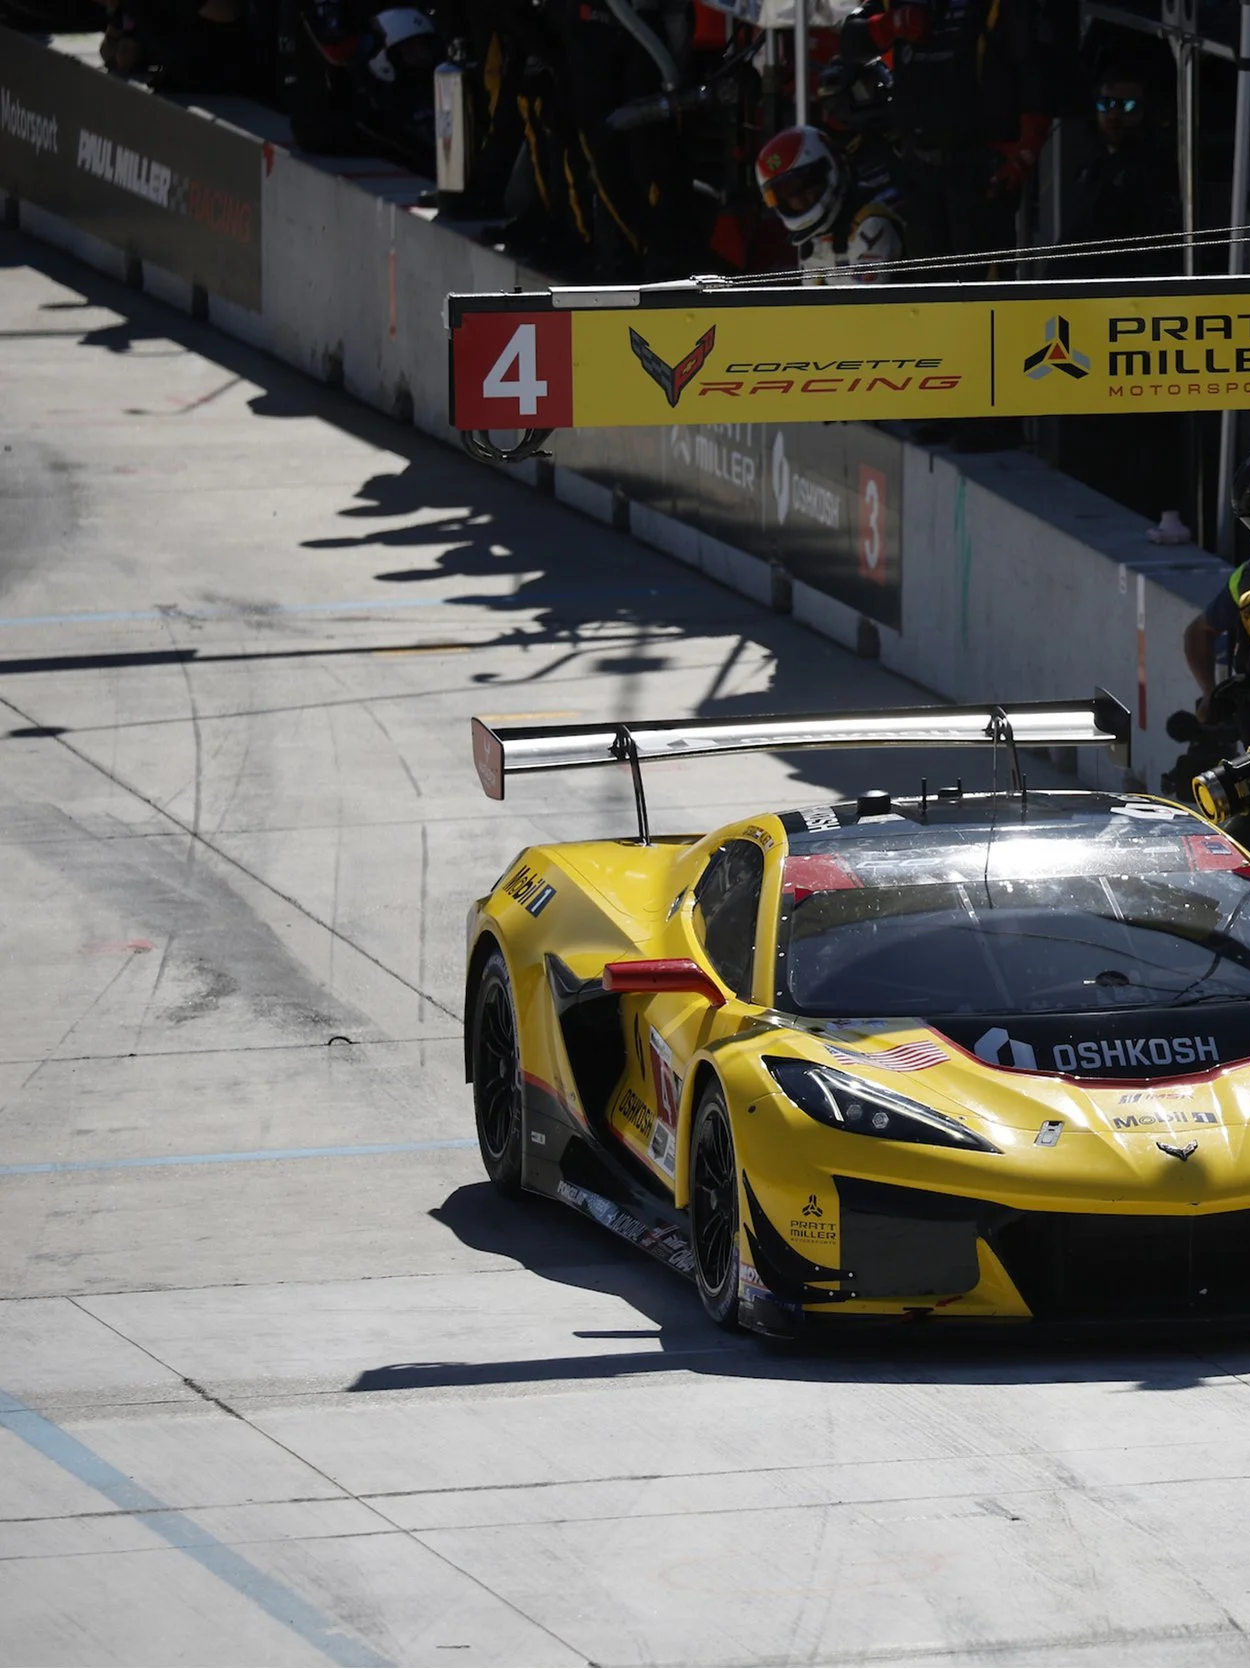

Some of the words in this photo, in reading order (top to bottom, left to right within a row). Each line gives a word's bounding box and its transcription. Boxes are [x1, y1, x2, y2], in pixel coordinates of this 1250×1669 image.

[0, 86, 59, 156] Motorsport
[77, 127, 115, 182] PAUL
[113, 144, 172, 209] MILLER
[188, 180, 254, 245] RACING
[482, 323, 548, 416] 4
[725, 358, 943, 373] CORVETTE
[699, 375, 962, 397] RACING
[695, 435, 755, 491] MILLER
[792, 473, 841, 530] OSHKOSH
[864, 479, 880, 569] 3
[503, 865, 546, 905] Mobil
[1052, 1036, 1220, 1071] OSHKOSH
[1112, 1112, 1188, 1129] Mobil
[790, 1220, 837, 1231] PRATT
[790, 1229, 836, 1239] MILLER
